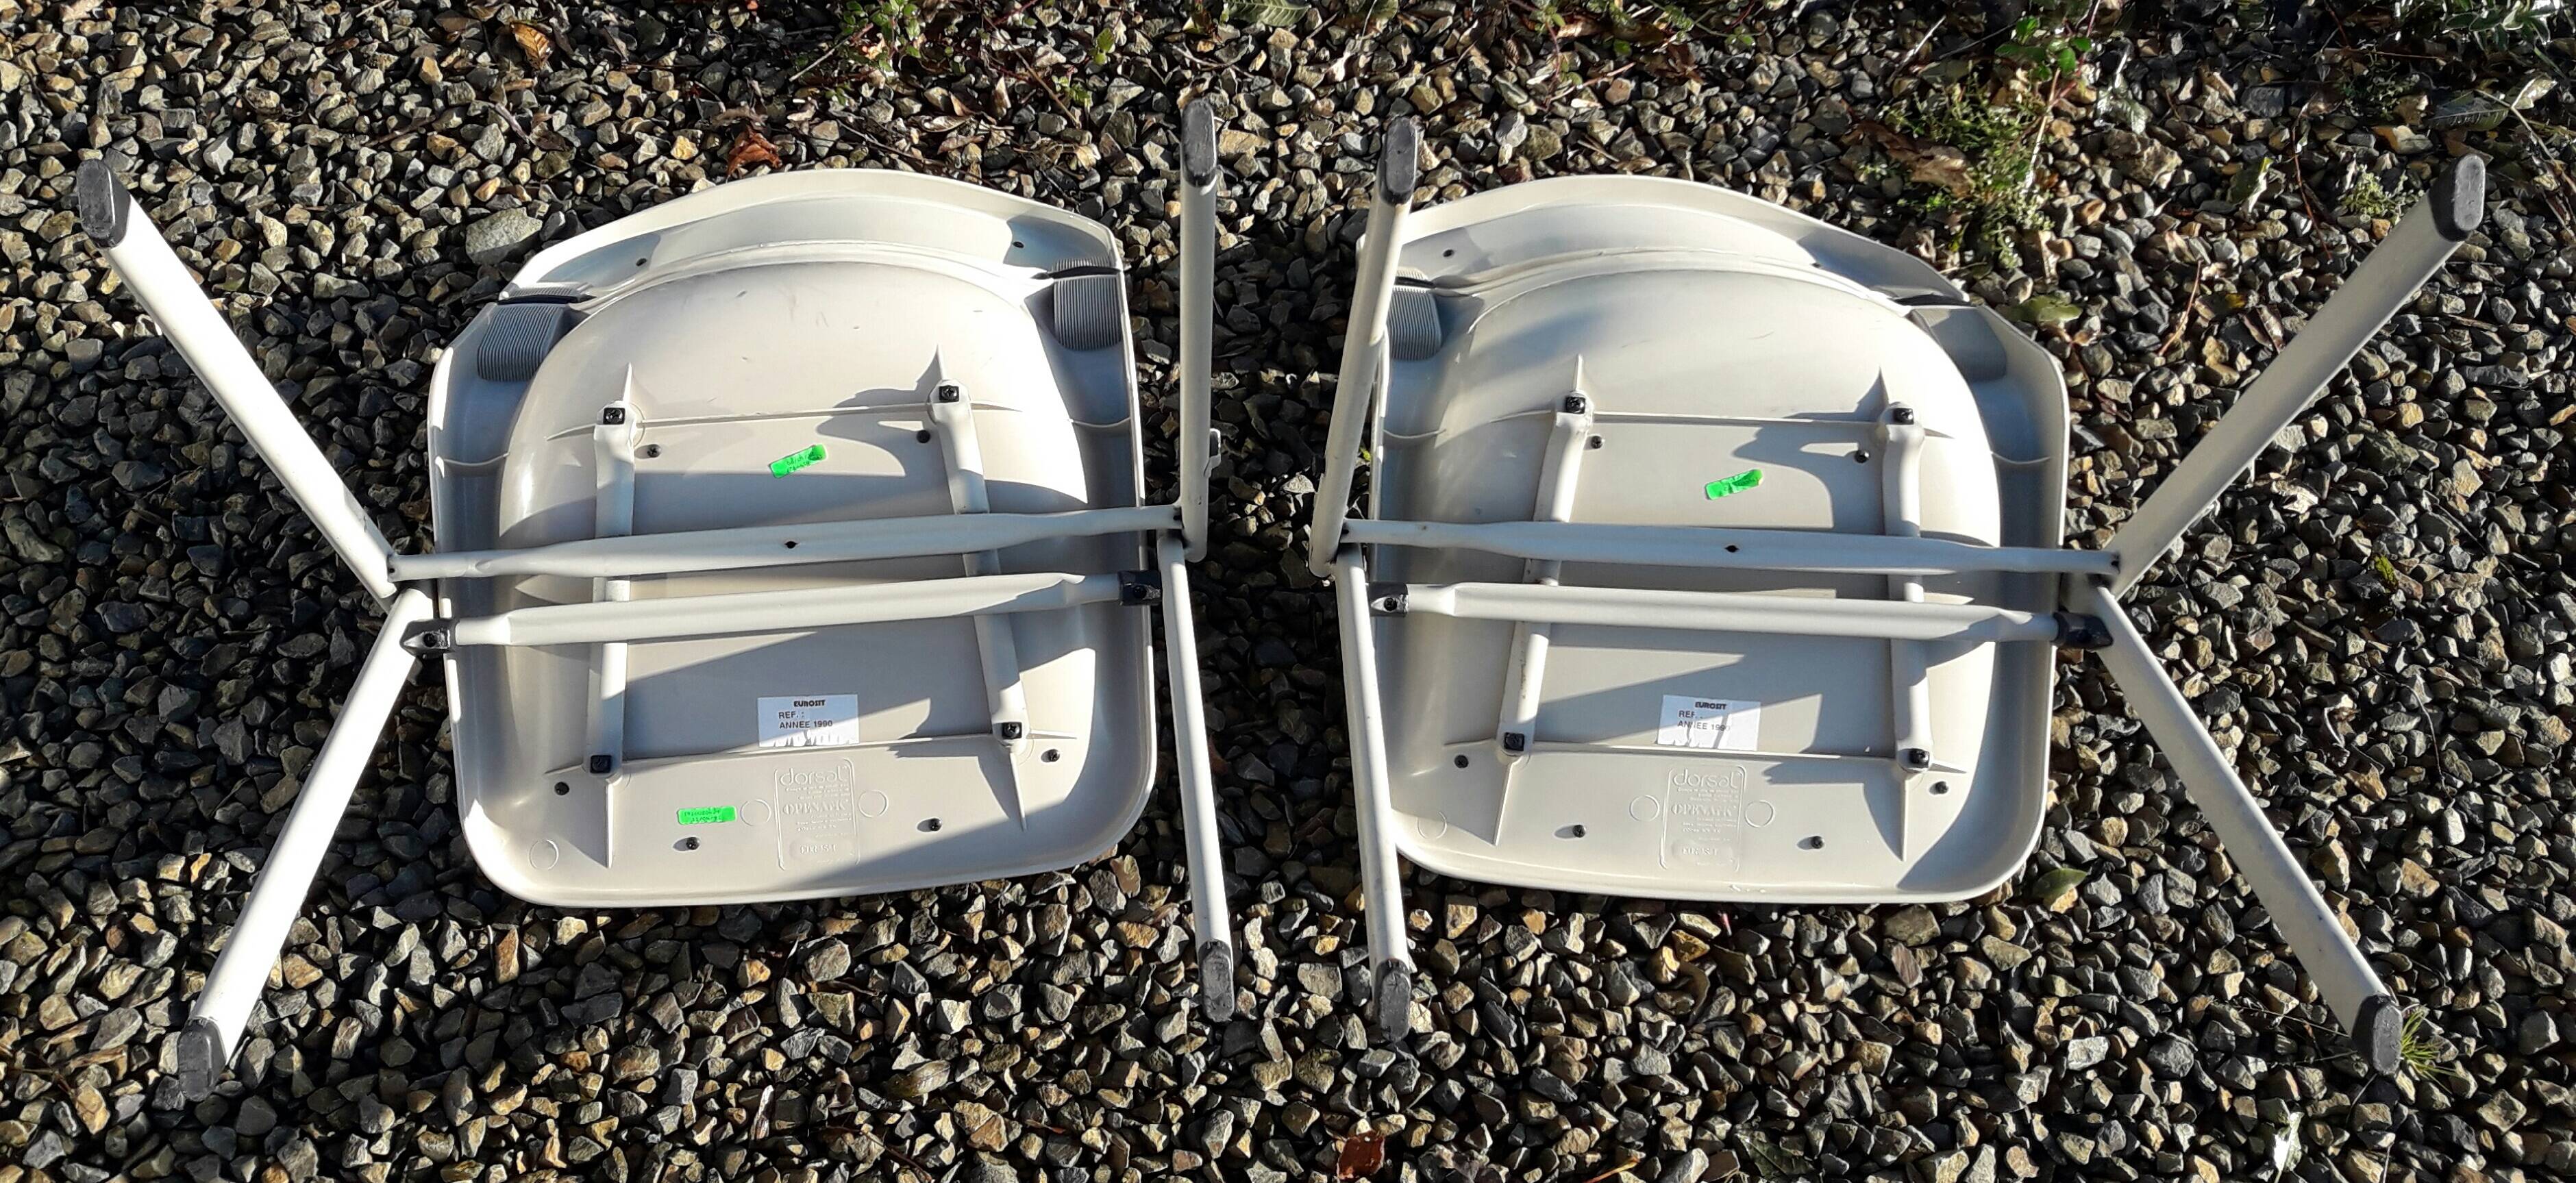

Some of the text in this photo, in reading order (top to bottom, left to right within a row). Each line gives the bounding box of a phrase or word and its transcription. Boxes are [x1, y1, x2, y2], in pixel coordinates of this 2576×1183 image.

[780, 721, 810, 729] ANNEE
[779, 765, 843, 786] dorsal
[1673, 769, 1737, 788] dorsal
